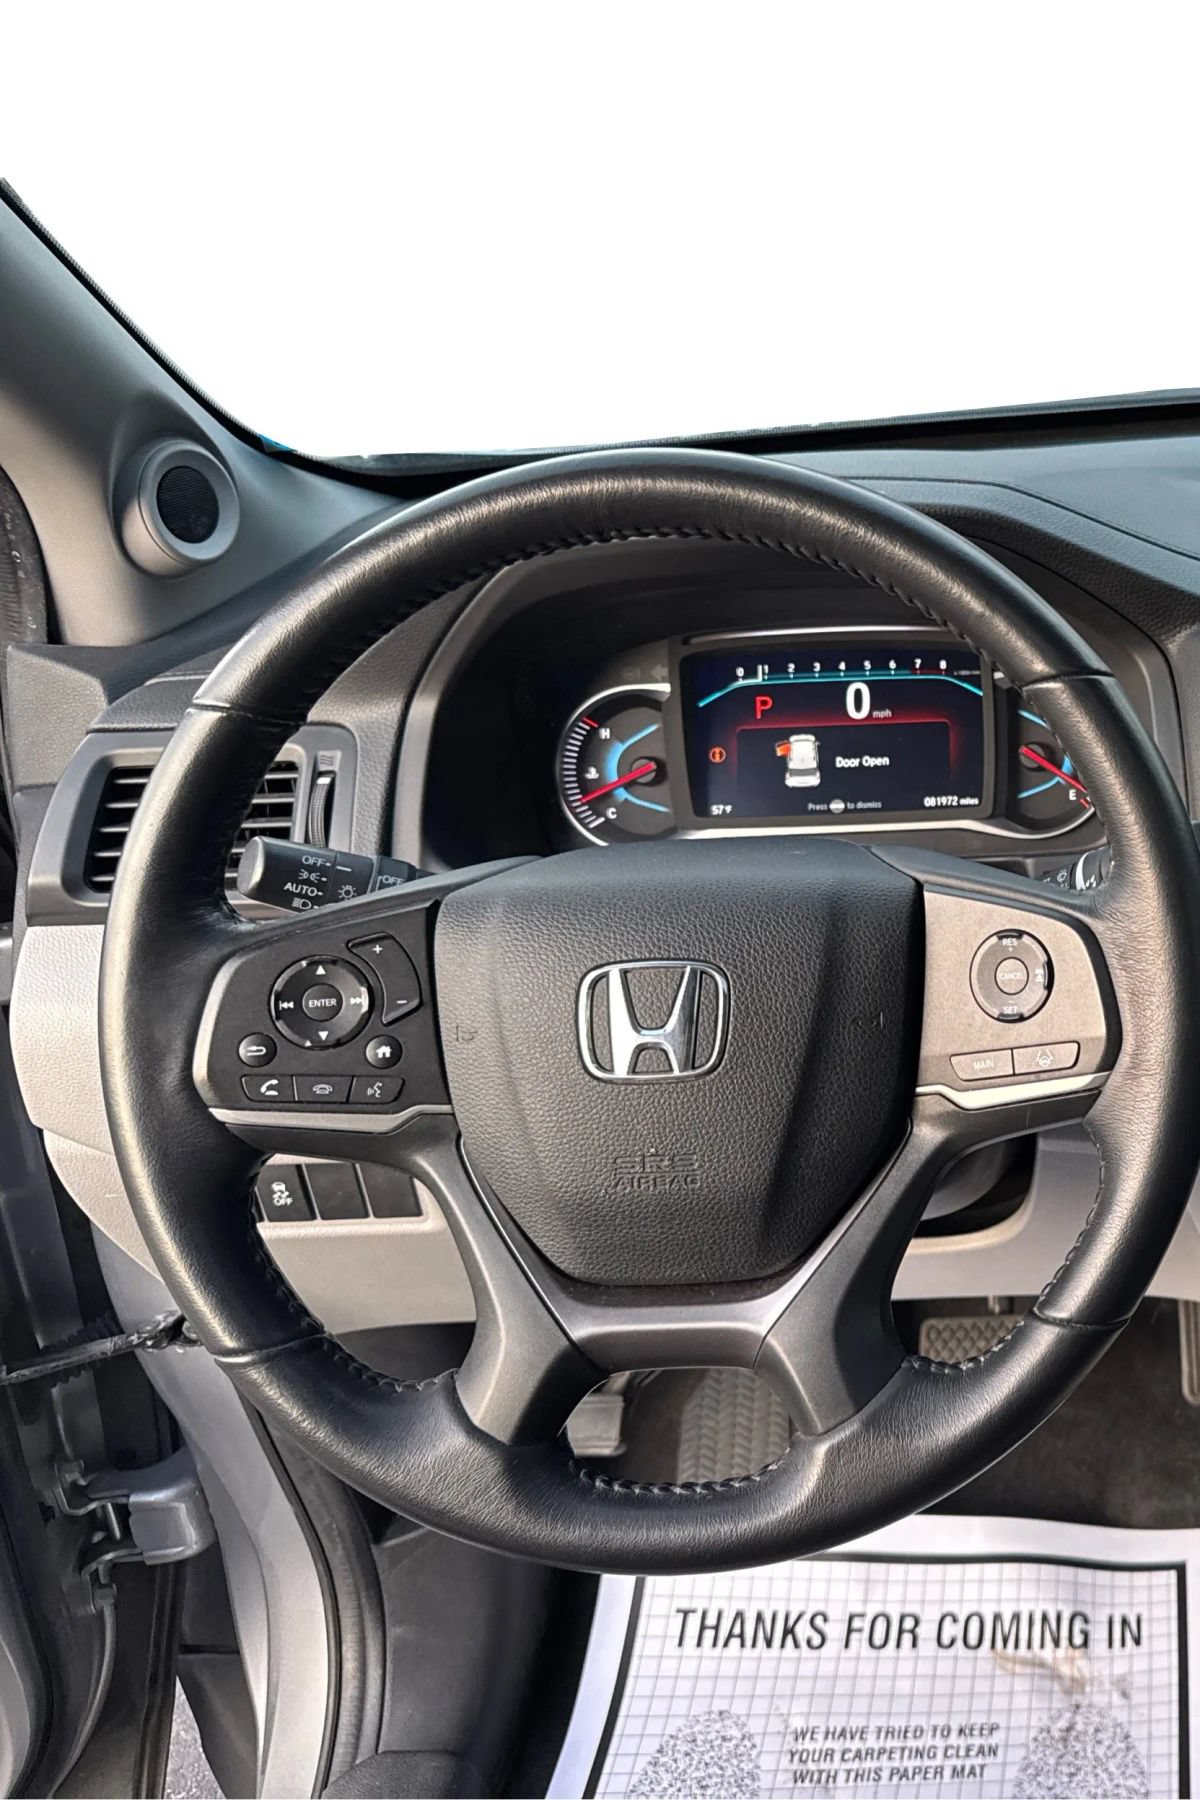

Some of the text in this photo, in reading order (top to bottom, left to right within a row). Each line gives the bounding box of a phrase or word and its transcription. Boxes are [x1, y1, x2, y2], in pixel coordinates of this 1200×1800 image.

[736, 667, 745, 676] 0
[787, 663, 796, 673] 2
[813, 662, 821, 672] 3
[838, 661, 846, 671] 4
[863, 660, 872, 670] 5
[888, 660, 897, 669] 6
[914, 658, 922, 668] 7
[939, 660, 947, 670] 8
[845, 682, 892, 720] 0 mph
[755, 696, 773, 719] P
[599, 728, 611, 739] H
[835, 755, 890, 768] Door Open
[1069, 789, 1076, 800] E
[807, 802, 828, 812] Press
[846, 801, 855, 810] to
[856, 801, 882, 810] dismiss
[923, 795, 979, 807] 081972 miles
[606, 807, 617, 819] C
[302, 855, 326, 867] OFF
[283, 882, 319, 897] AUTO
[1002, 938, 1018, 946] RES
[1000, 972, 1025, 980] CANCEL
[309, 998, 337, 1008] ENTER
[1003, 1006, 1018, 1014] SET
[974, 1060, 994, 1070] MAIN
[274, 1197, 293, 1206] OFF
[675, 1607, 1143, 1650] THANKS FOR COMING IN
[794, 1722, 1000, 1742] WE HAVE TRIED TO KEEP
[788, 1743, 999, 1764] YOUR CARPETING CLEAN
[793, 1763, 986, 1784] WITH THIS PAPER MAT
